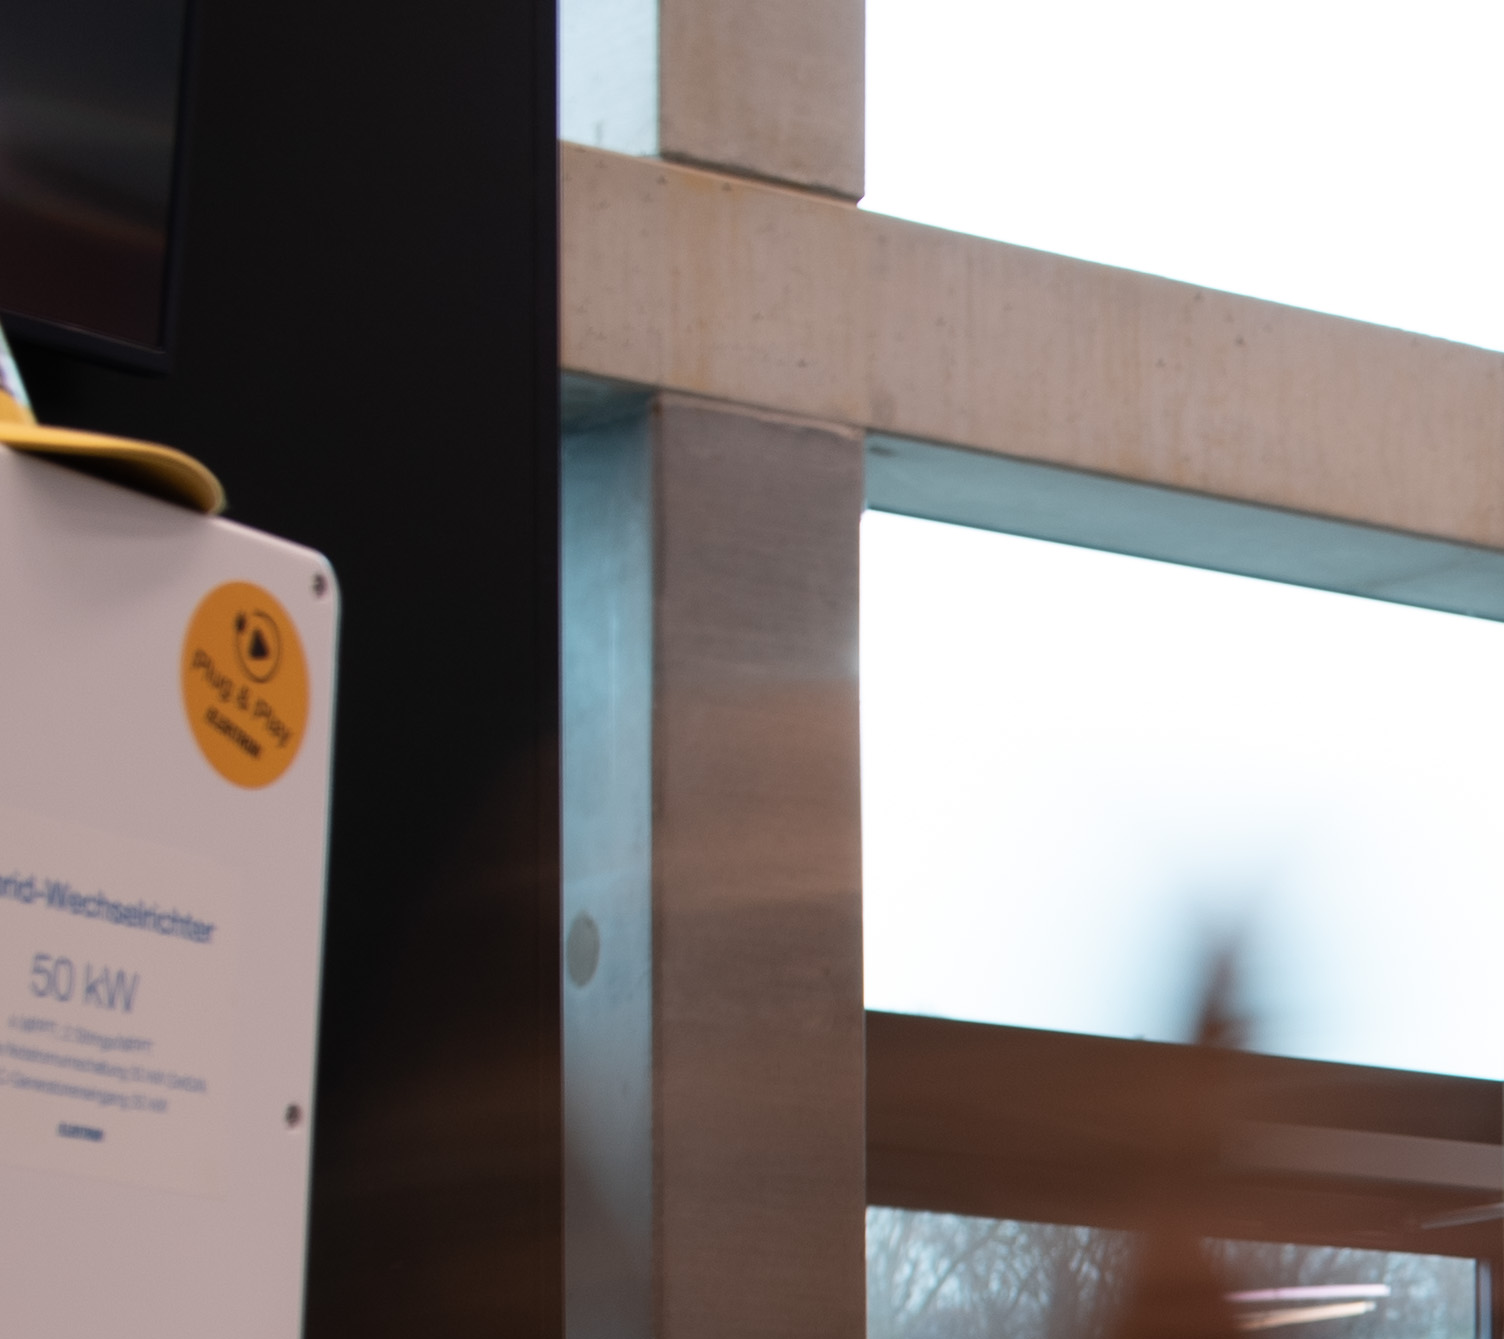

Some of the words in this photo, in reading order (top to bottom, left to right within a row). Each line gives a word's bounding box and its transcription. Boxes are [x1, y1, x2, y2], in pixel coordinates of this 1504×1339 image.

[0, 872, 214, 943] rid-Wechselrichter
[32, 953, 74, 1002] 50
[83, 962, 140, 1013] kW
